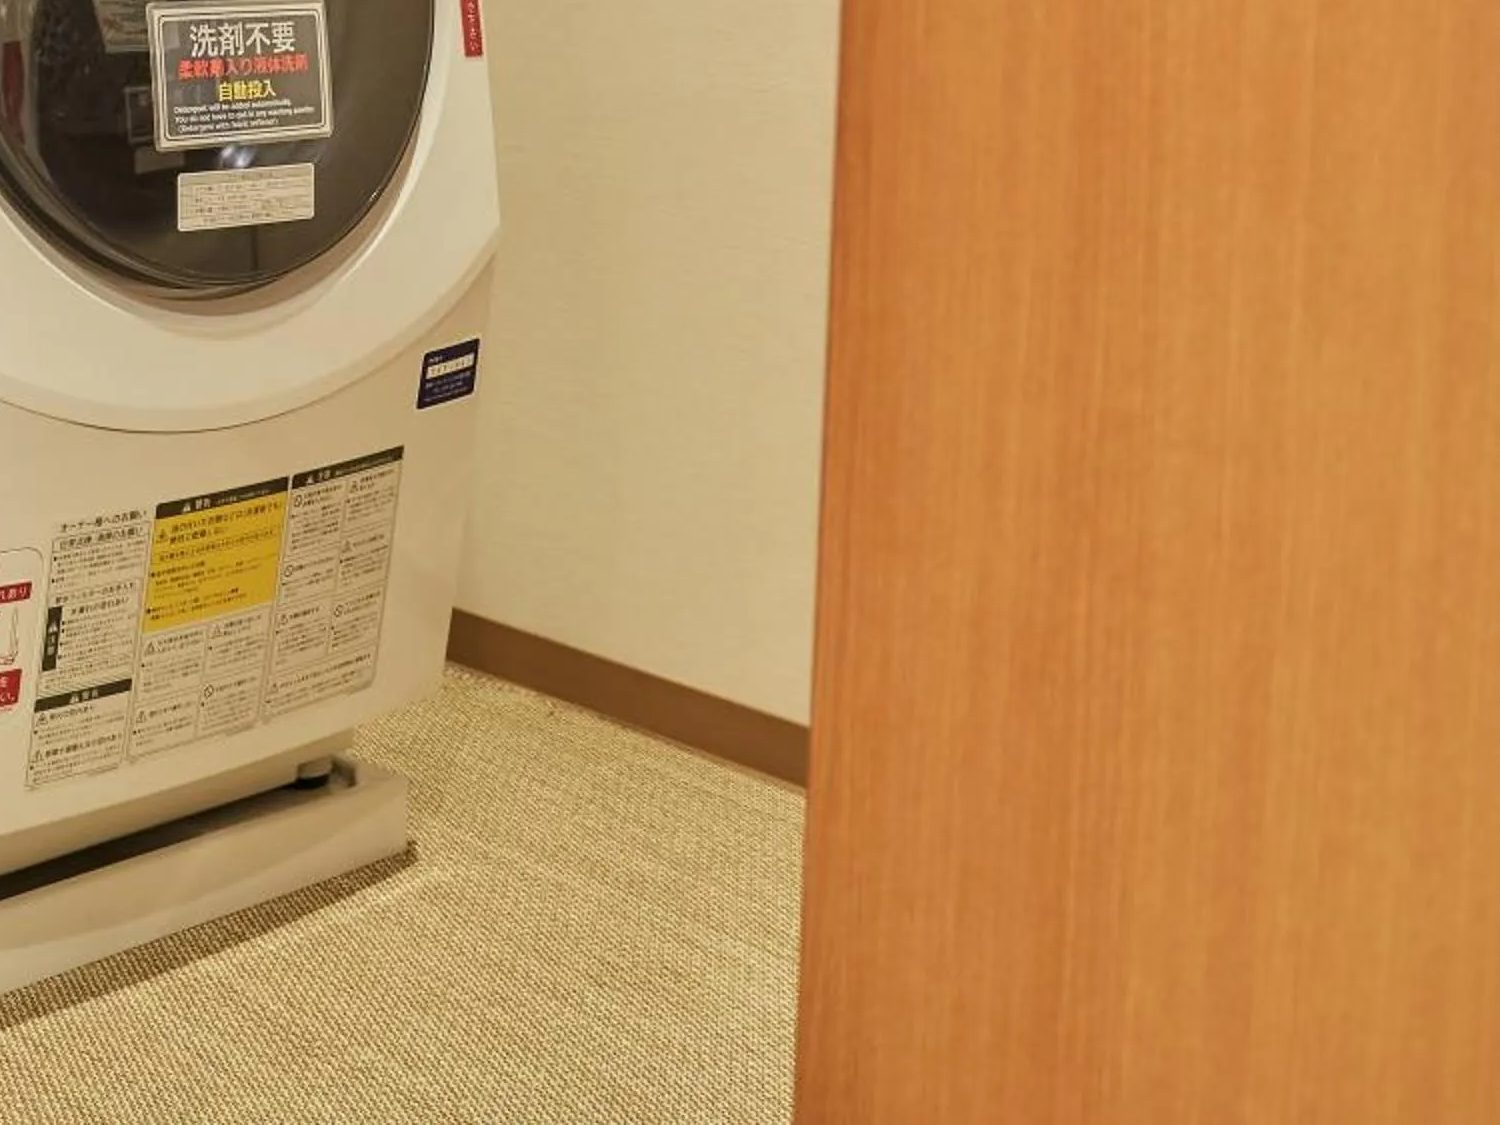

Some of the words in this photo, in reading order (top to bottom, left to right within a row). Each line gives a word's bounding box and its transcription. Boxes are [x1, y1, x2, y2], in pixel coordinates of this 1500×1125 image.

[189, 21, 297, 57] 洗剤不要
[218, 80, 278, 102] 自動投入
